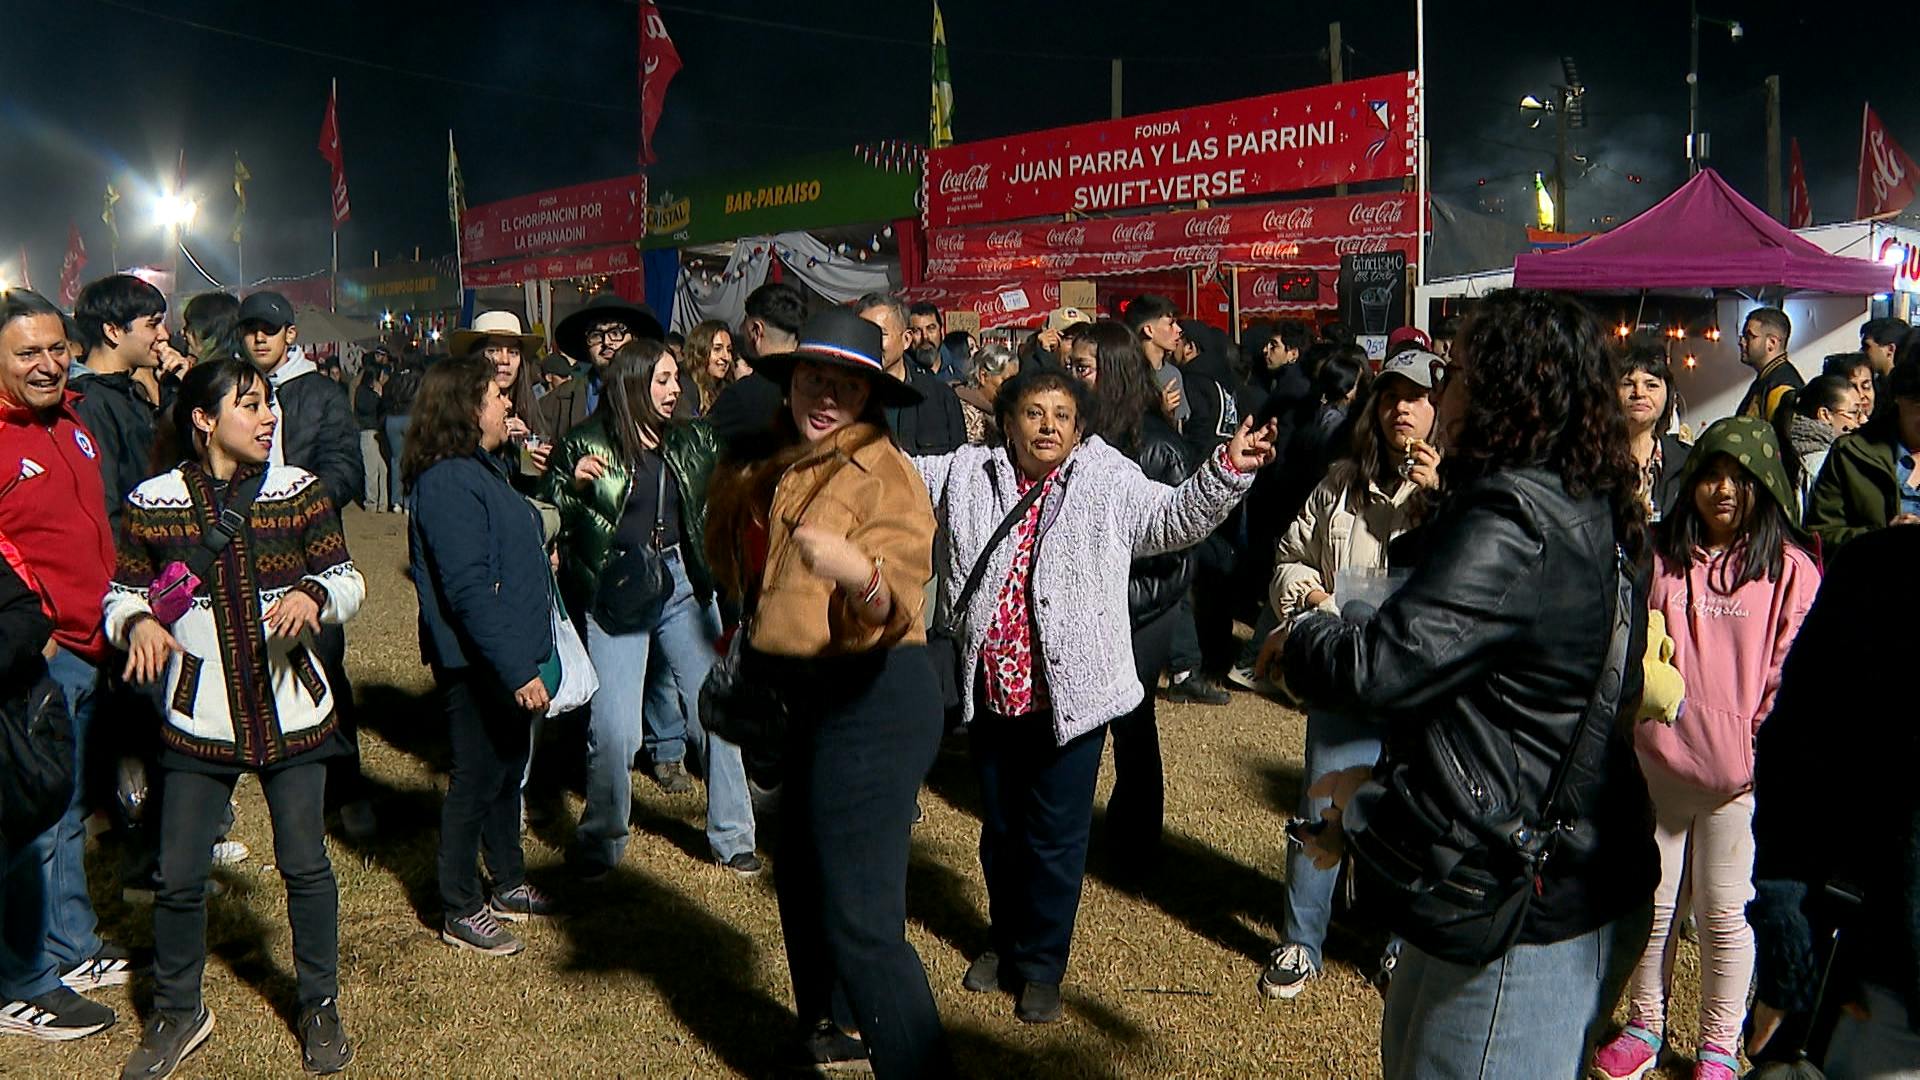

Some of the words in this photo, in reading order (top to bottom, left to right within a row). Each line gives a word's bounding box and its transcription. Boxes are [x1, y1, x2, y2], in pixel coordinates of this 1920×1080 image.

[1135, 121, 1181, 140] FONDA
[1009, 157, 1062, 185] JUAN
[1069, 147, 1145, 177] PARRA
[1151, 143, 1166, 167] Y
[1172, 136, 1219, 165] LAS
[1227, 120, 1334, 158] PARRINI
[725, 179, 821, 215] BAR-PARAISO
[1074, 168, 1246, 209] SWIFT-VERSE
[501, 218, 512, 232] EL
[513, 207, 579, 231] CHORIPANCINI
[580, 203, 602, 219] POR
[514, 236, 526, 250] LA
[527, 226, 586, 247] EMPANADINI
